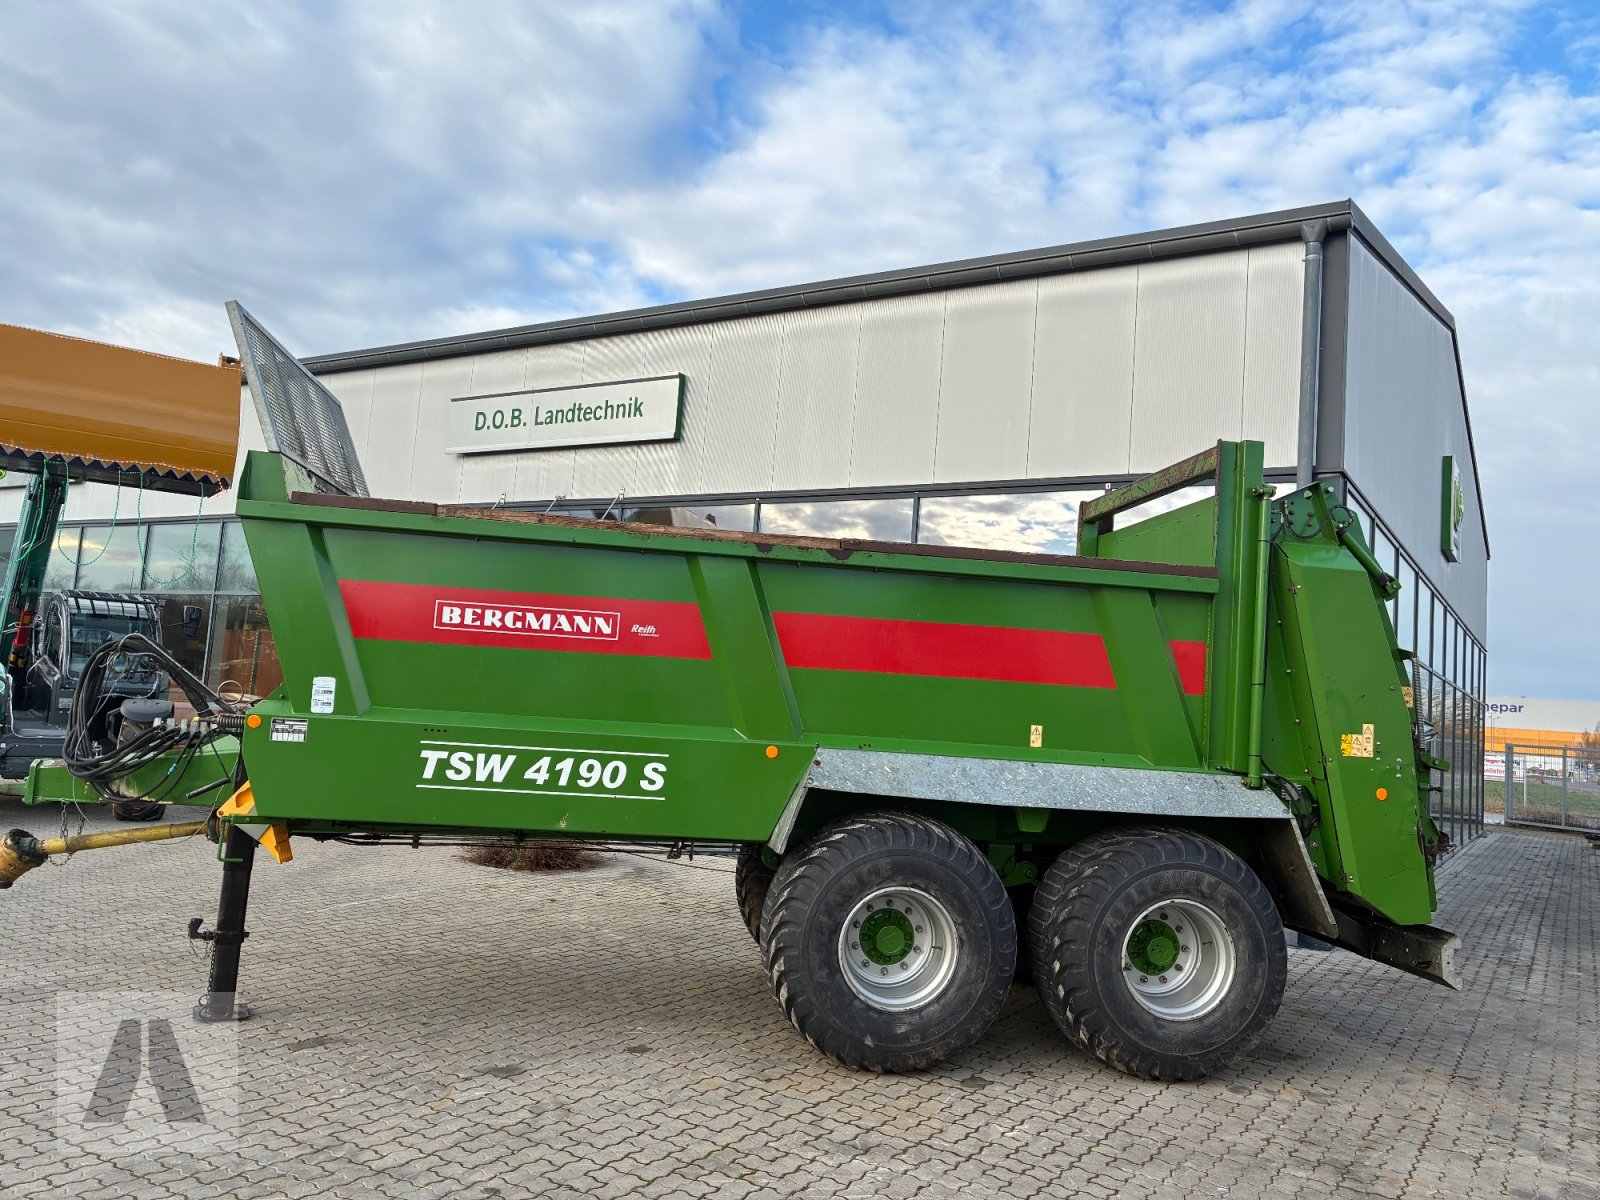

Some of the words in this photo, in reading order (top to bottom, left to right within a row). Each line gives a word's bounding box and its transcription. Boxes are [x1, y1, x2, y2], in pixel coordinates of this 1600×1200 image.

[474, 408, 527, 431] D.O.B.
[534, 396, 644, 426] Landtechnik
[441, 605, 613, 635] BERGMANN
[631, 624, 656, 634] Reith
[420, 749, 517, 783] TSW
[523, 756, 627, 789] 4190
[639, 762, 667, 791] S
